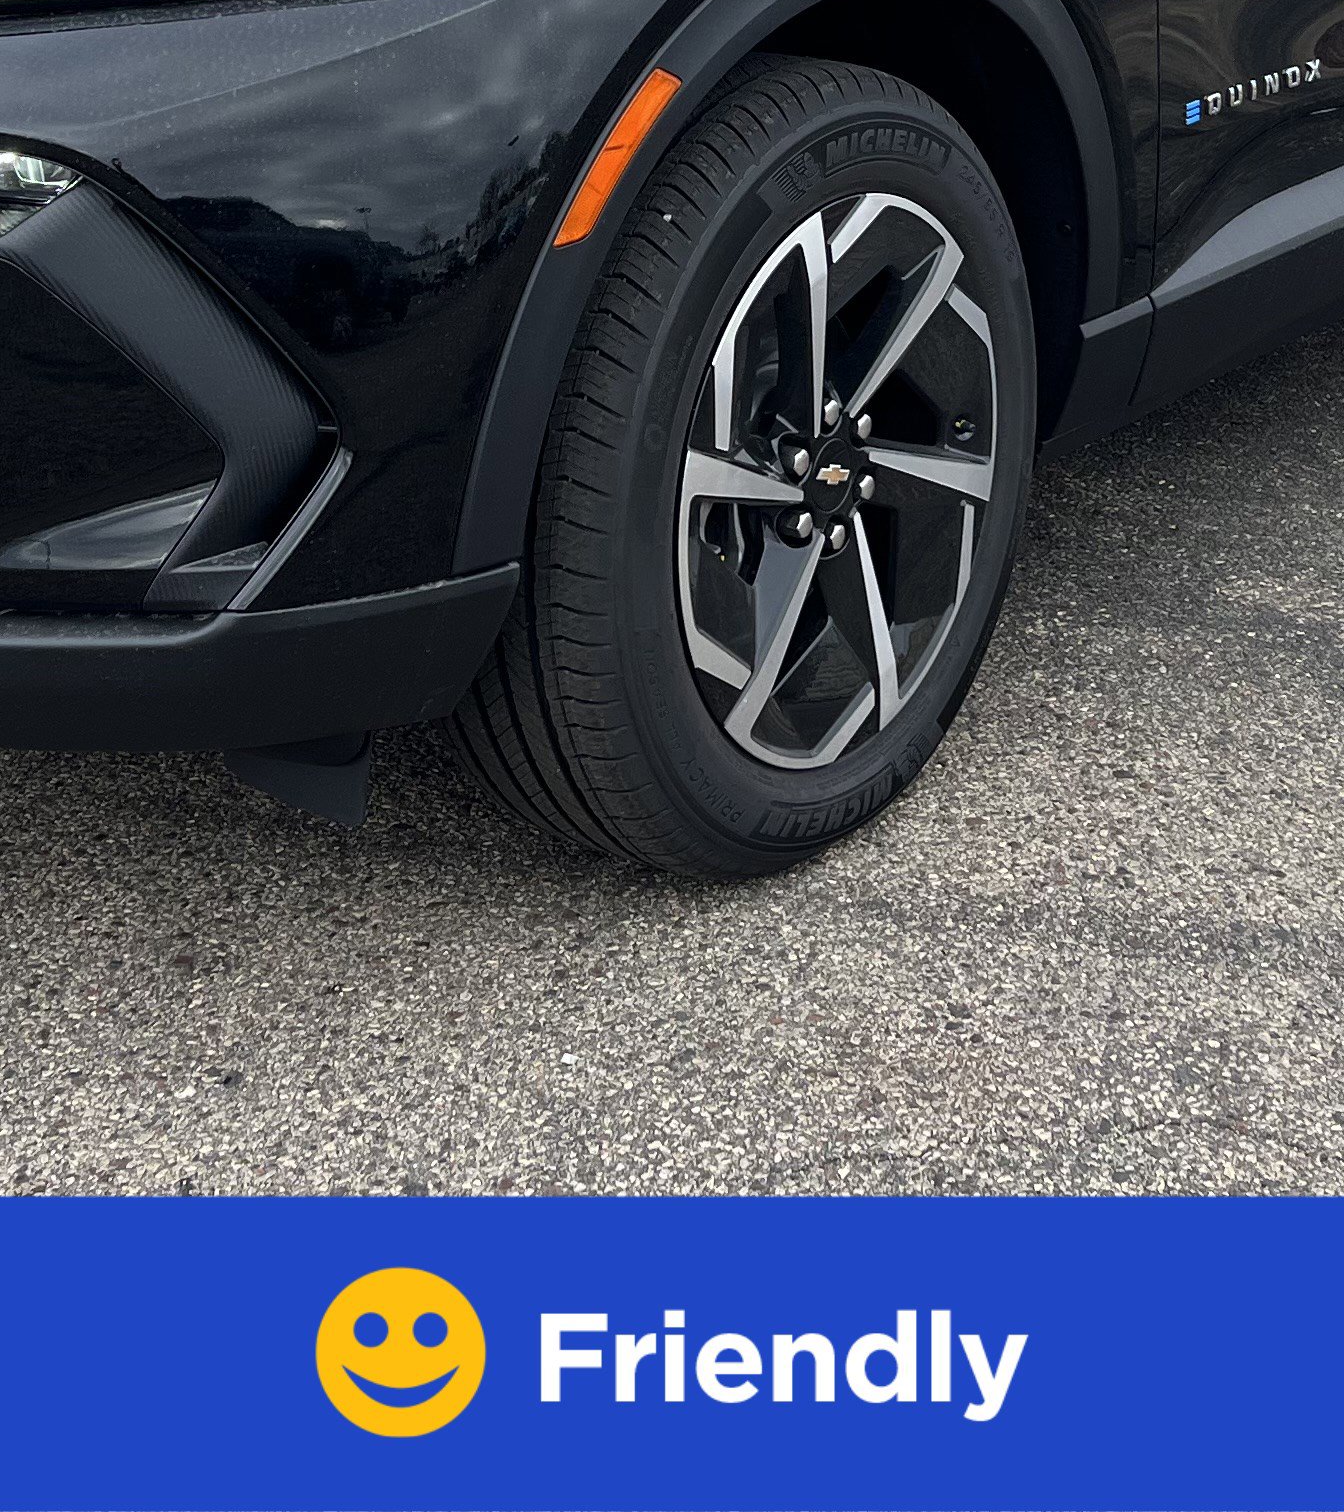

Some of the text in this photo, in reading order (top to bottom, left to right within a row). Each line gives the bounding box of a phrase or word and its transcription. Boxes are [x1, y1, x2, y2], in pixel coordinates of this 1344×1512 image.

[1185, 59, 1322, 127] EQUINOX
[825, 128, 947, 174] MICHELIN
[678, 758, 746, 824] PRIMACY
[759, 770, 894, 839] MICHELIN
